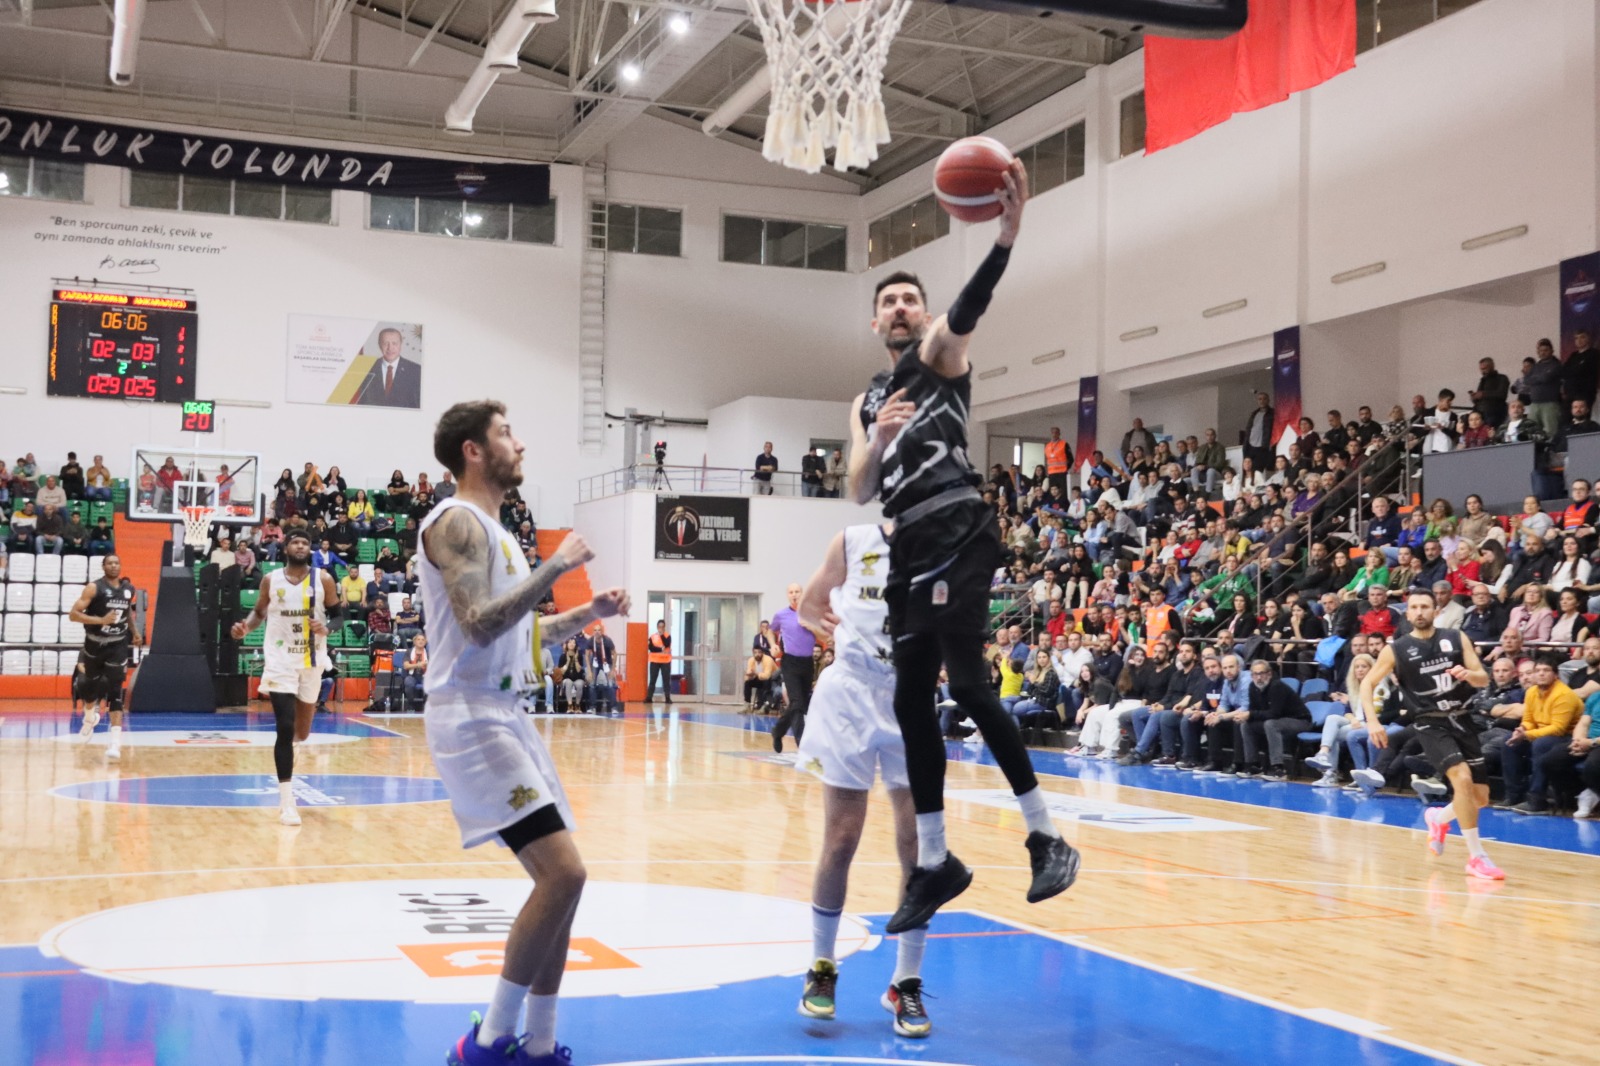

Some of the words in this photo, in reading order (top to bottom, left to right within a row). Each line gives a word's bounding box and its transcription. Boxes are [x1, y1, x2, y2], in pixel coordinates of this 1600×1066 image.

[182, 138, 394, 186] YOLUNDA
[80, 219, 139, 232] sporcunun
[141, 224, 166, 236] zeki,
[169, 227, 198, 239] çevik
[200, 231, 213, 239] ve
[34, 232, 59, 242] aynı
[62, 233, 114, 246] zamanda
[117, 236, 176, 251] ahlaklısını
[101, 312, 148, 331] 06:06
[91, 339, 116, 358] 02
[131, 342, 155, 361] 03
[118, 362, 128, 375] 2
[87, 375, 121, 394] 029
[123, 377, 157, 397] 025
[183, 401, 213, 414] 06:06
[185, 413, 210, 430] 20
[292, 623, 303, 633] 35
[1431, 672, 1452, 692] 10
